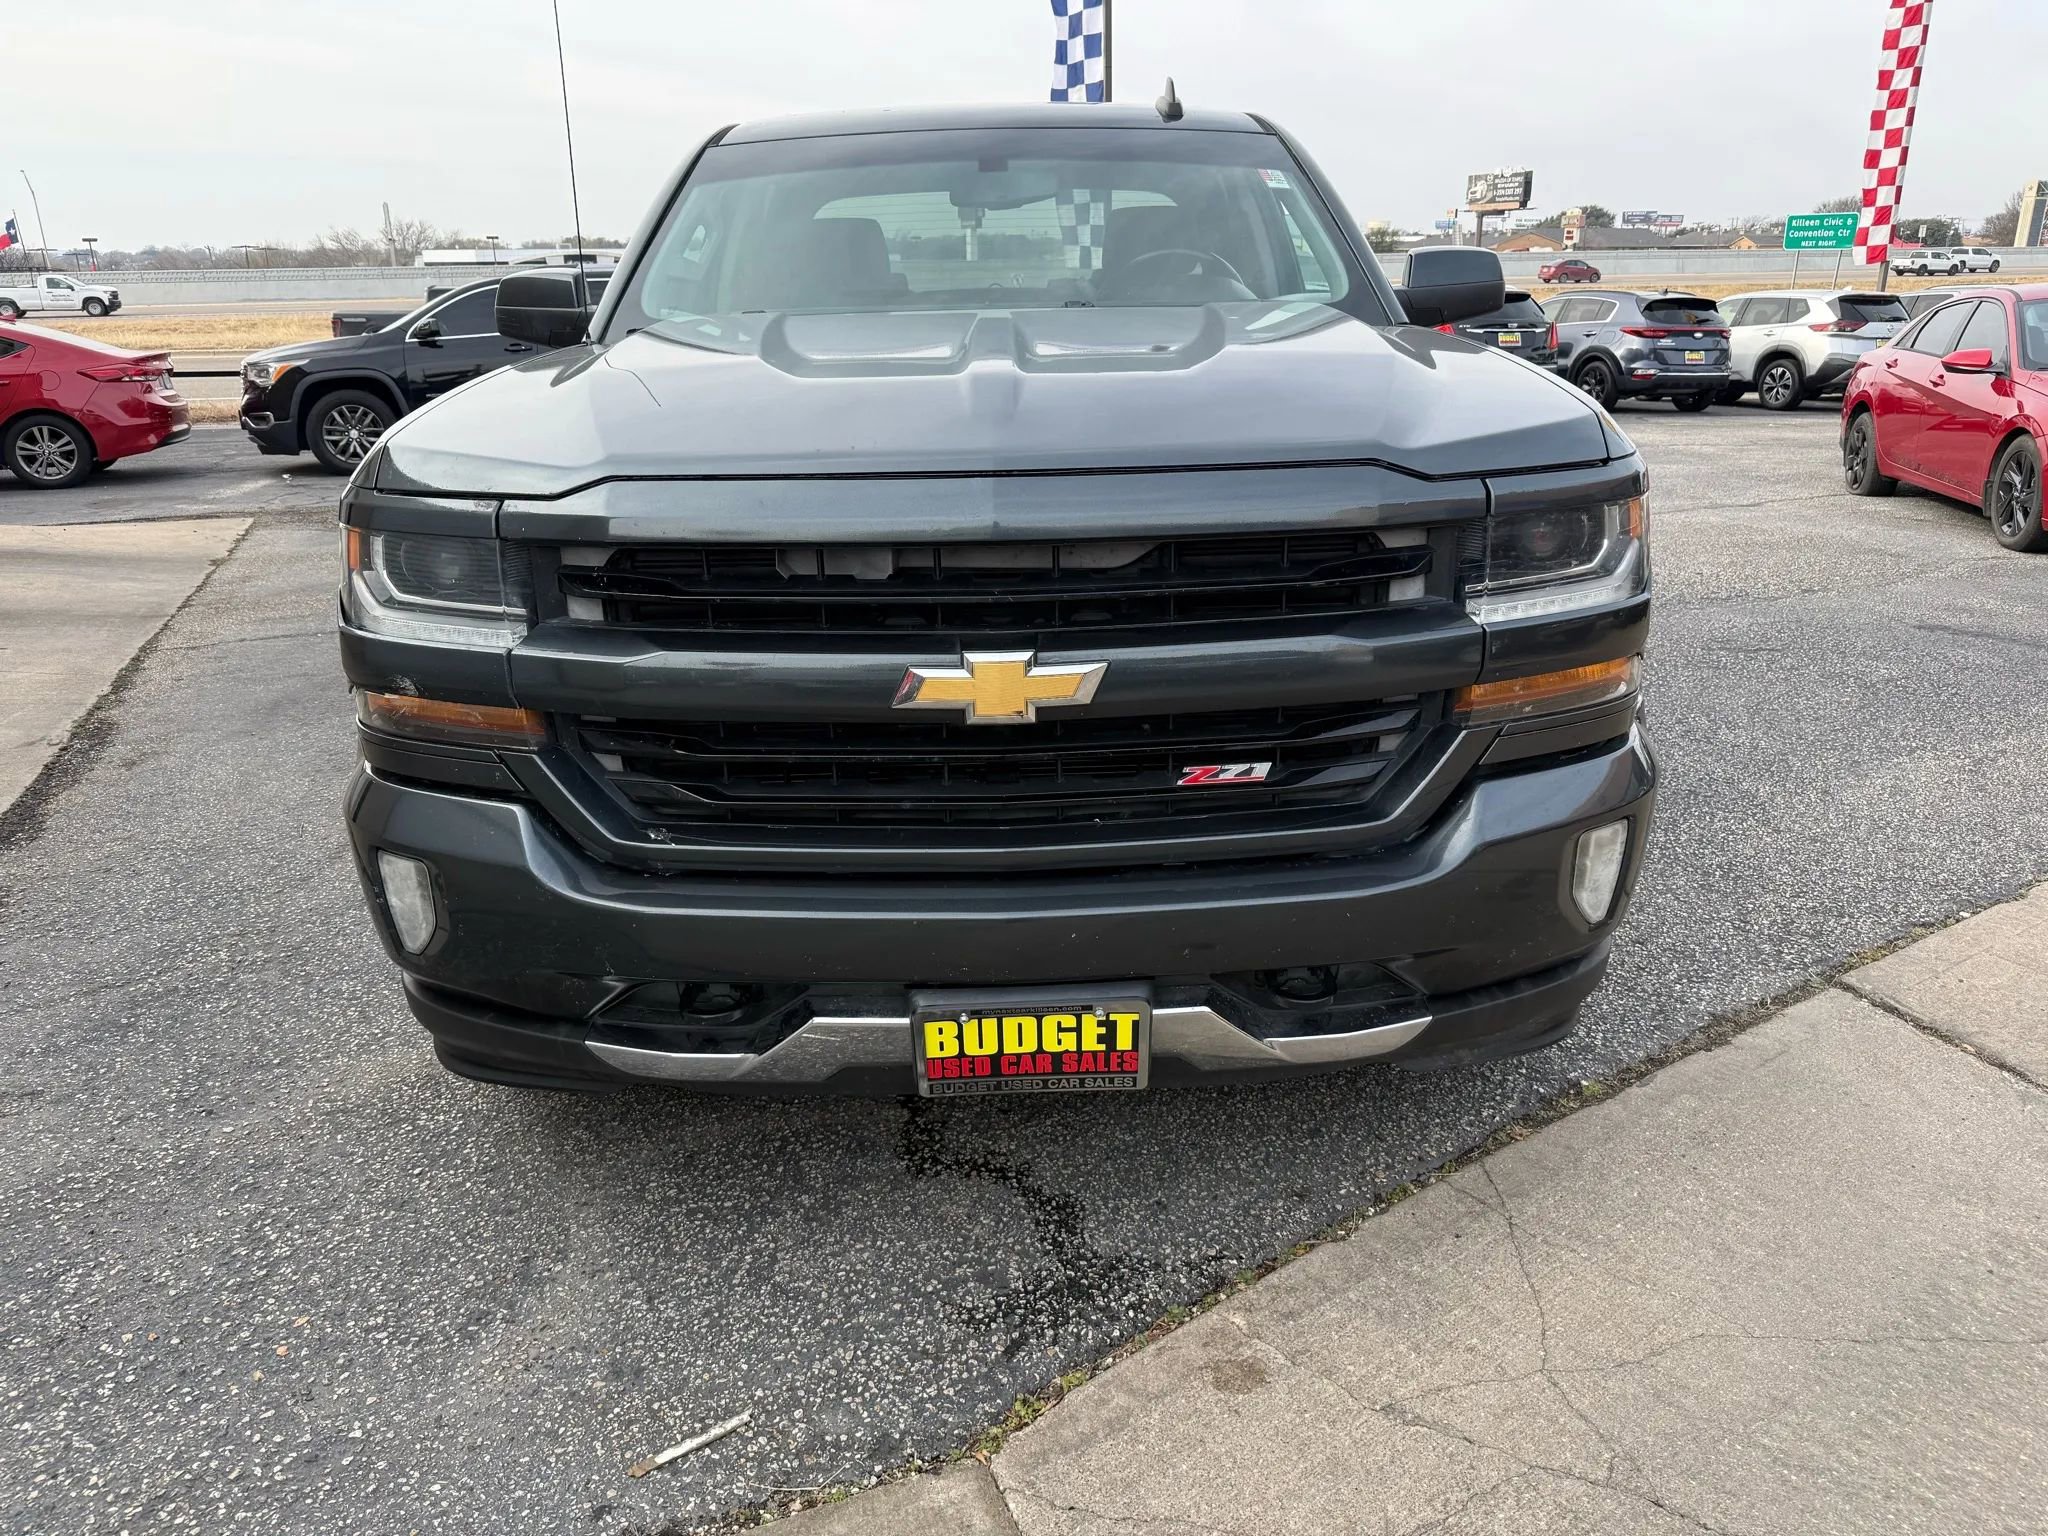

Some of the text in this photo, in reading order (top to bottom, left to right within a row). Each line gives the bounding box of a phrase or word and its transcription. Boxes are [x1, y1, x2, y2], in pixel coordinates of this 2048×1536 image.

[1792, 218, 1820, 226] Killeen
[1823, 218, 1843, 226] Civic
[1788, 229, 1834, 237] Convention
[1176, 762, 1272, 785] Z71
[924, 1013, 1140, 1058] BUDGET
[927, 1051, 1139, 1079] USED CAR SALES
[932, 1077, 1134, 1094] BUDGET USED CAR SALES
